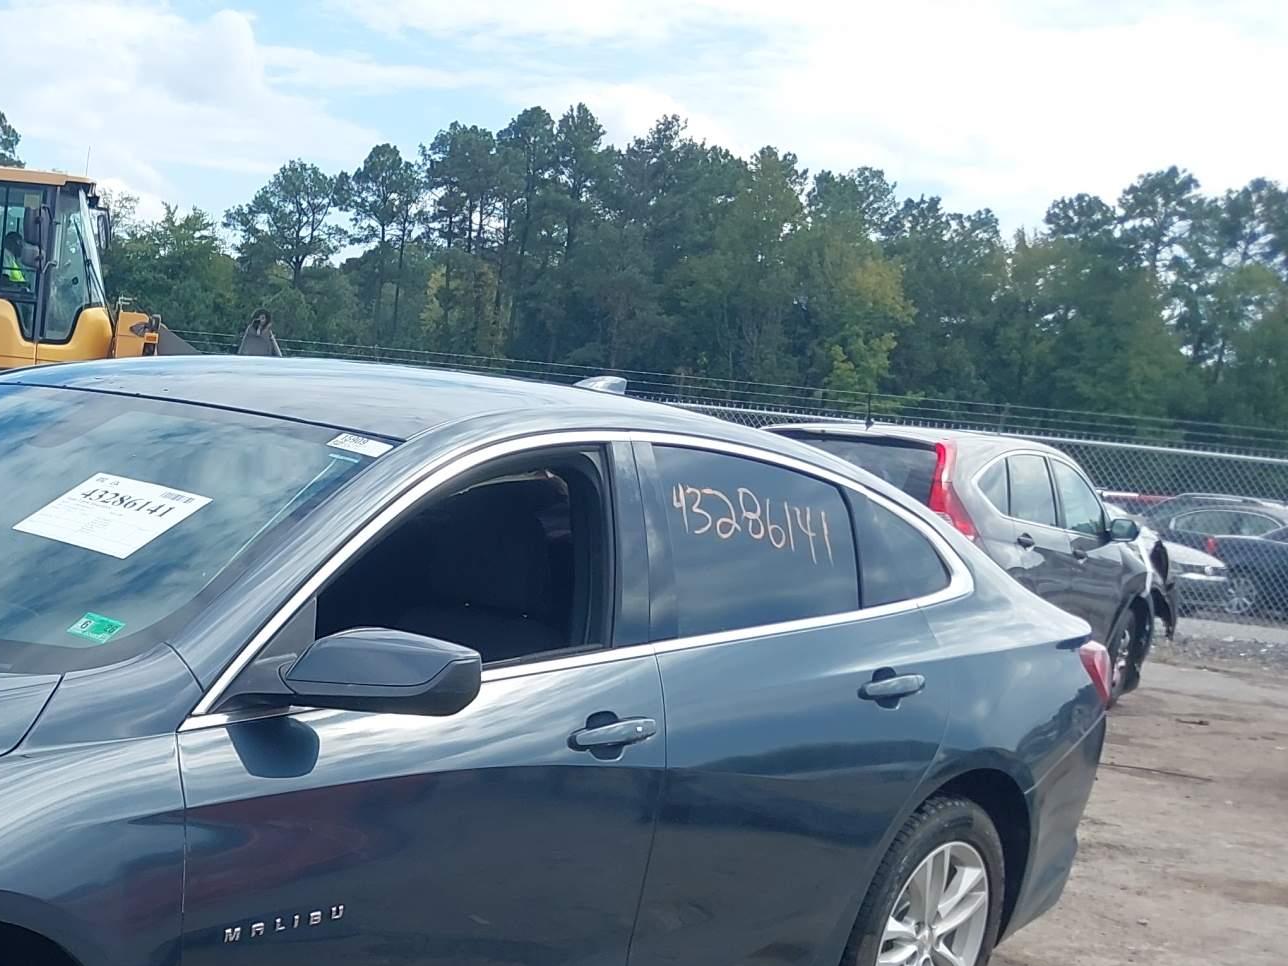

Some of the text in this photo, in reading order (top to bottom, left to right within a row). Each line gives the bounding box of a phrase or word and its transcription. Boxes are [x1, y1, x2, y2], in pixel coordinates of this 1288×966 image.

[81, 488, 175, 517] 43286141
[673, 482, 833, 567] 43286141
[223, 904, 345, 943] MALIBU
